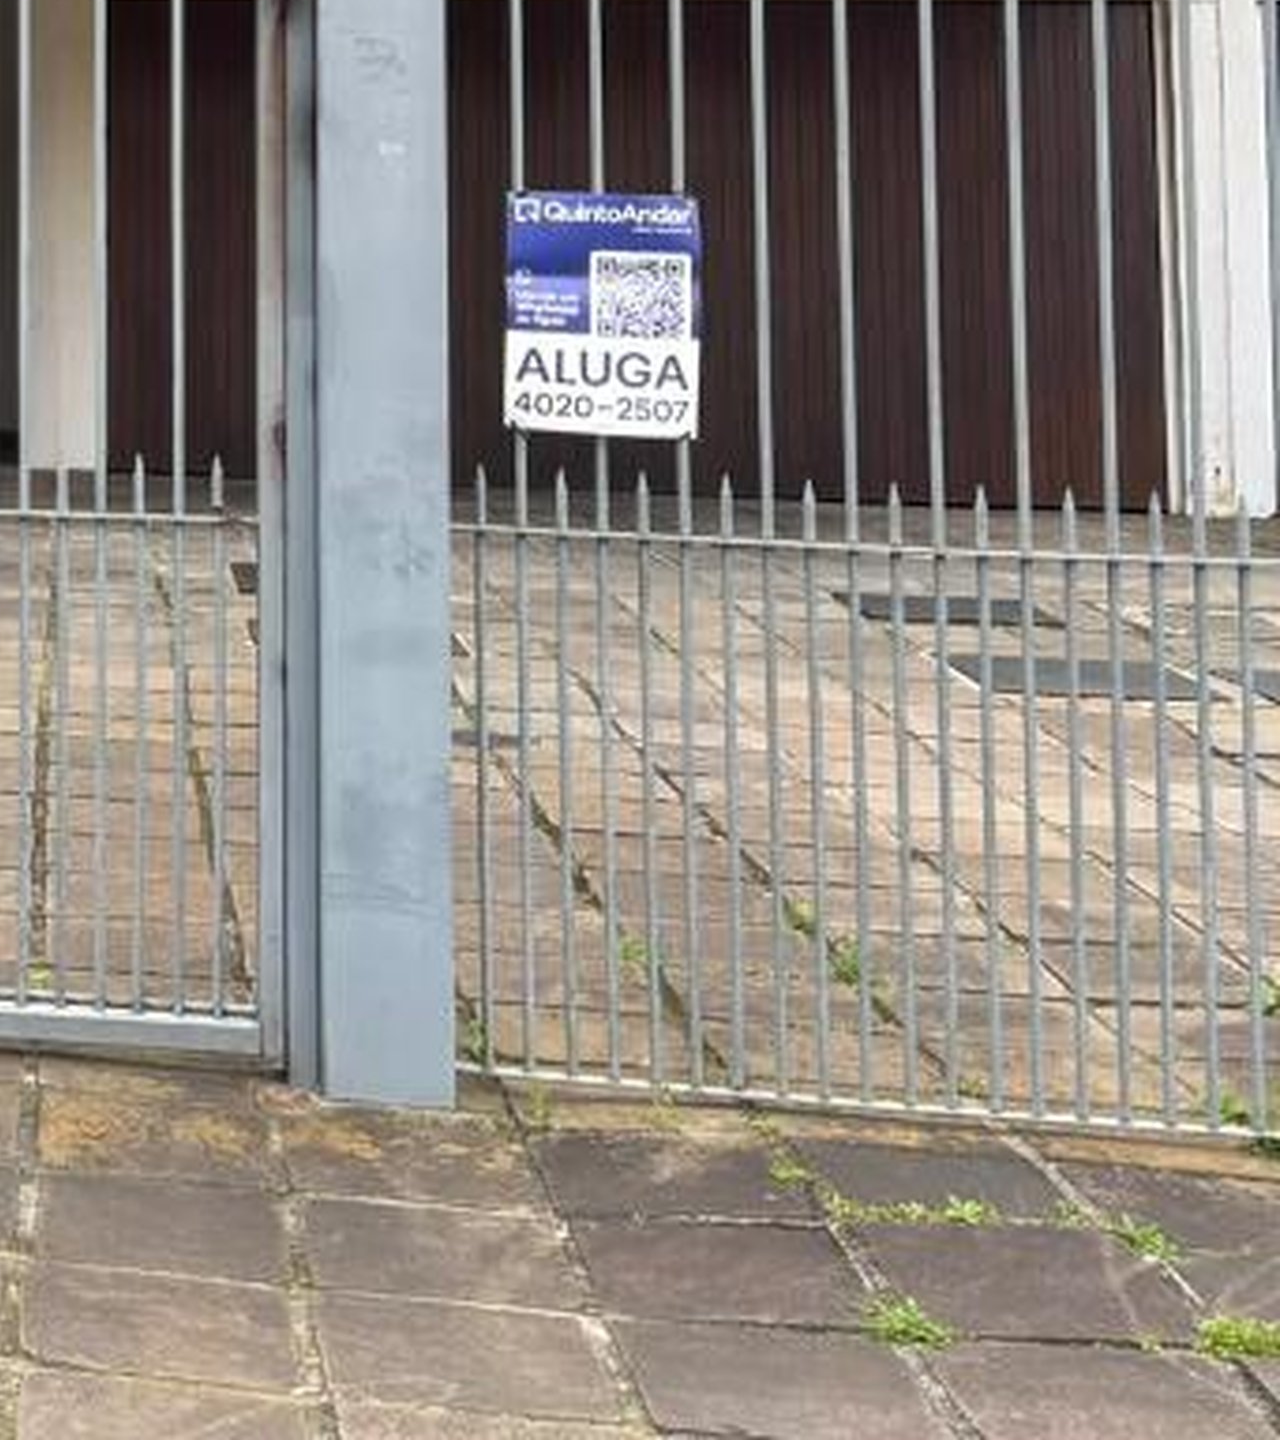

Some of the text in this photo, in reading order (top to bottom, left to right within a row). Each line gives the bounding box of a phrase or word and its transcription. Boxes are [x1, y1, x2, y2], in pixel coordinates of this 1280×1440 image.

[543, 201, 691, 225] QuintoAndar
[516, 347, 689, 390] ALUGA
[514, 392, 689, 423] 4020-2507
